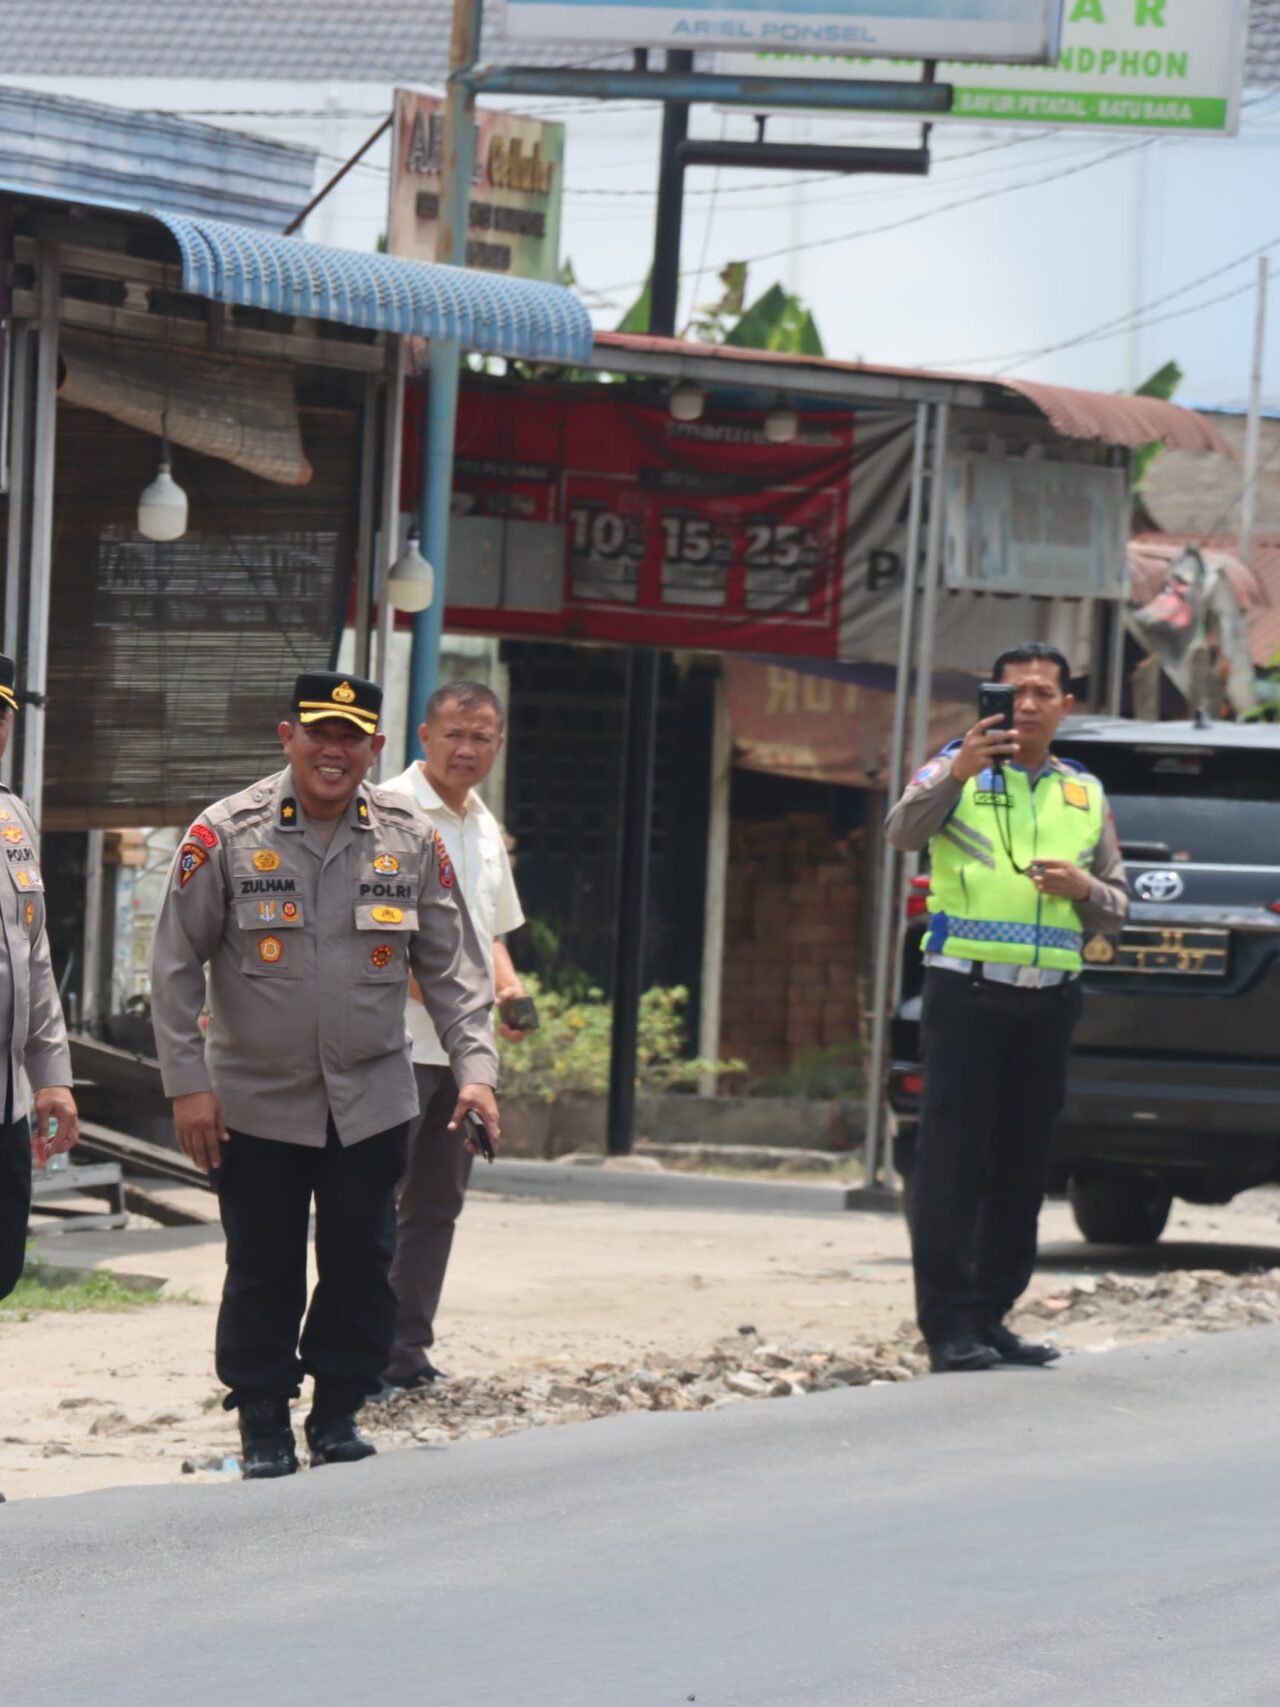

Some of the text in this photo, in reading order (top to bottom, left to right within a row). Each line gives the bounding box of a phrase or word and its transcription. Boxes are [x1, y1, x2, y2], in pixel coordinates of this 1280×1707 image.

[672, 18, 878, 43] ARIEL PONSEL
[1010, 47, 1189, 79] NDPHON
[569, 508, 625, 555] 10
[661, 516, 712, 561] 15
[745, 524, 801, 567] 25
[5, 847, 36, 863] POLRI
[240, 878, 297, 895] ZULHAM
[359, 882, 412, 899] POLRI
